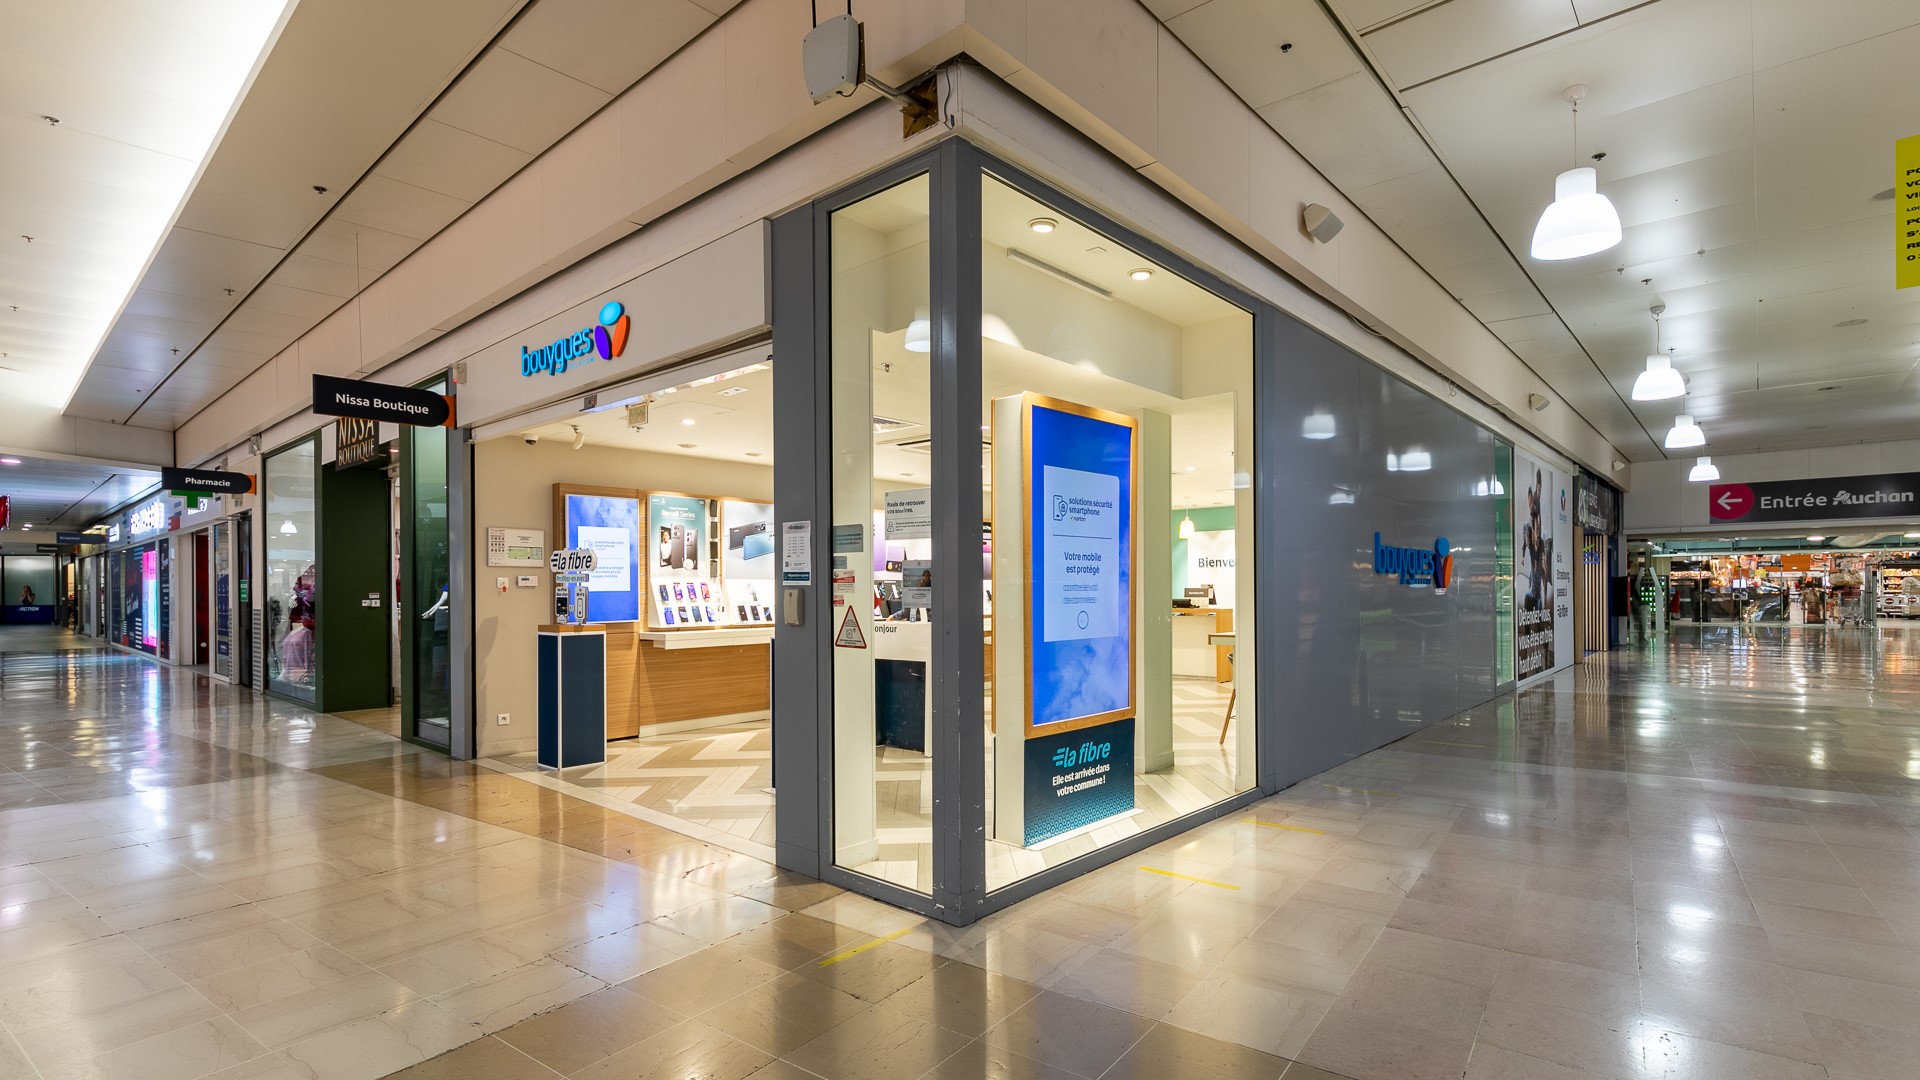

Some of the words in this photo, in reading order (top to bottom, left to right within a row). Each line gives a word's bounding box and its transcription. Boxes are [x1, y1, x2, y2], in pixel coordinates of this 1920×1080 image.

[521, 328, 594, 376] bouygues
[336, 393, 370, 407] Nissa
[373, 398, 429, 415] Boutique
[338, 417, 374, 448] NISSA
[338, 438, 375, 466] BOUTIQUE
[185, 477, 231, 487] Pharmacie
[1068, 497, 1092, 507] solutions
[1092, 500, 1113, 509] sécurité
[1761, 493, 1827, 509] Entrée
[1832, 490, 1914, 505] Auchan
[1068, 506, 1100, 516] smartphone
[557, 553, 567, 570] la
[567, 552, 592, 570] fibre
[1064, 551, 1081, 561] Votre
[1081, 552, 1102, 562] mobile
[1198, 557, 1235, 568] Bienve
[1374, 531, 1434, 585] bouygues
[1066, 565, 1076, 574] est
[1076, 565, 1100, 576] protégé
[1518, 606, 1551, 627] Détendez-vous,
[874, 625, 898, 635] onjour
[1518, 634, 1530, 650] vous
[1530, 629, 1540, 647] êtes
[1540, 631, 1545, 645] en
[1545, 627, 1553, 643] très
[1518, 656, 1531, 675] haut
[1063, 747, 1077, 768] la
[1078, 741, 1111, 764] fibre
[1052, 774, 1065, 786] Elle
[1064, 772, 1075, 782] est
[1074, 766, 1096, 780] arrivée
[1095, 763, 1111, 773] dans
[1056, 786, 1074, 797] votre
[1073, 778, 1103, 791] commune
